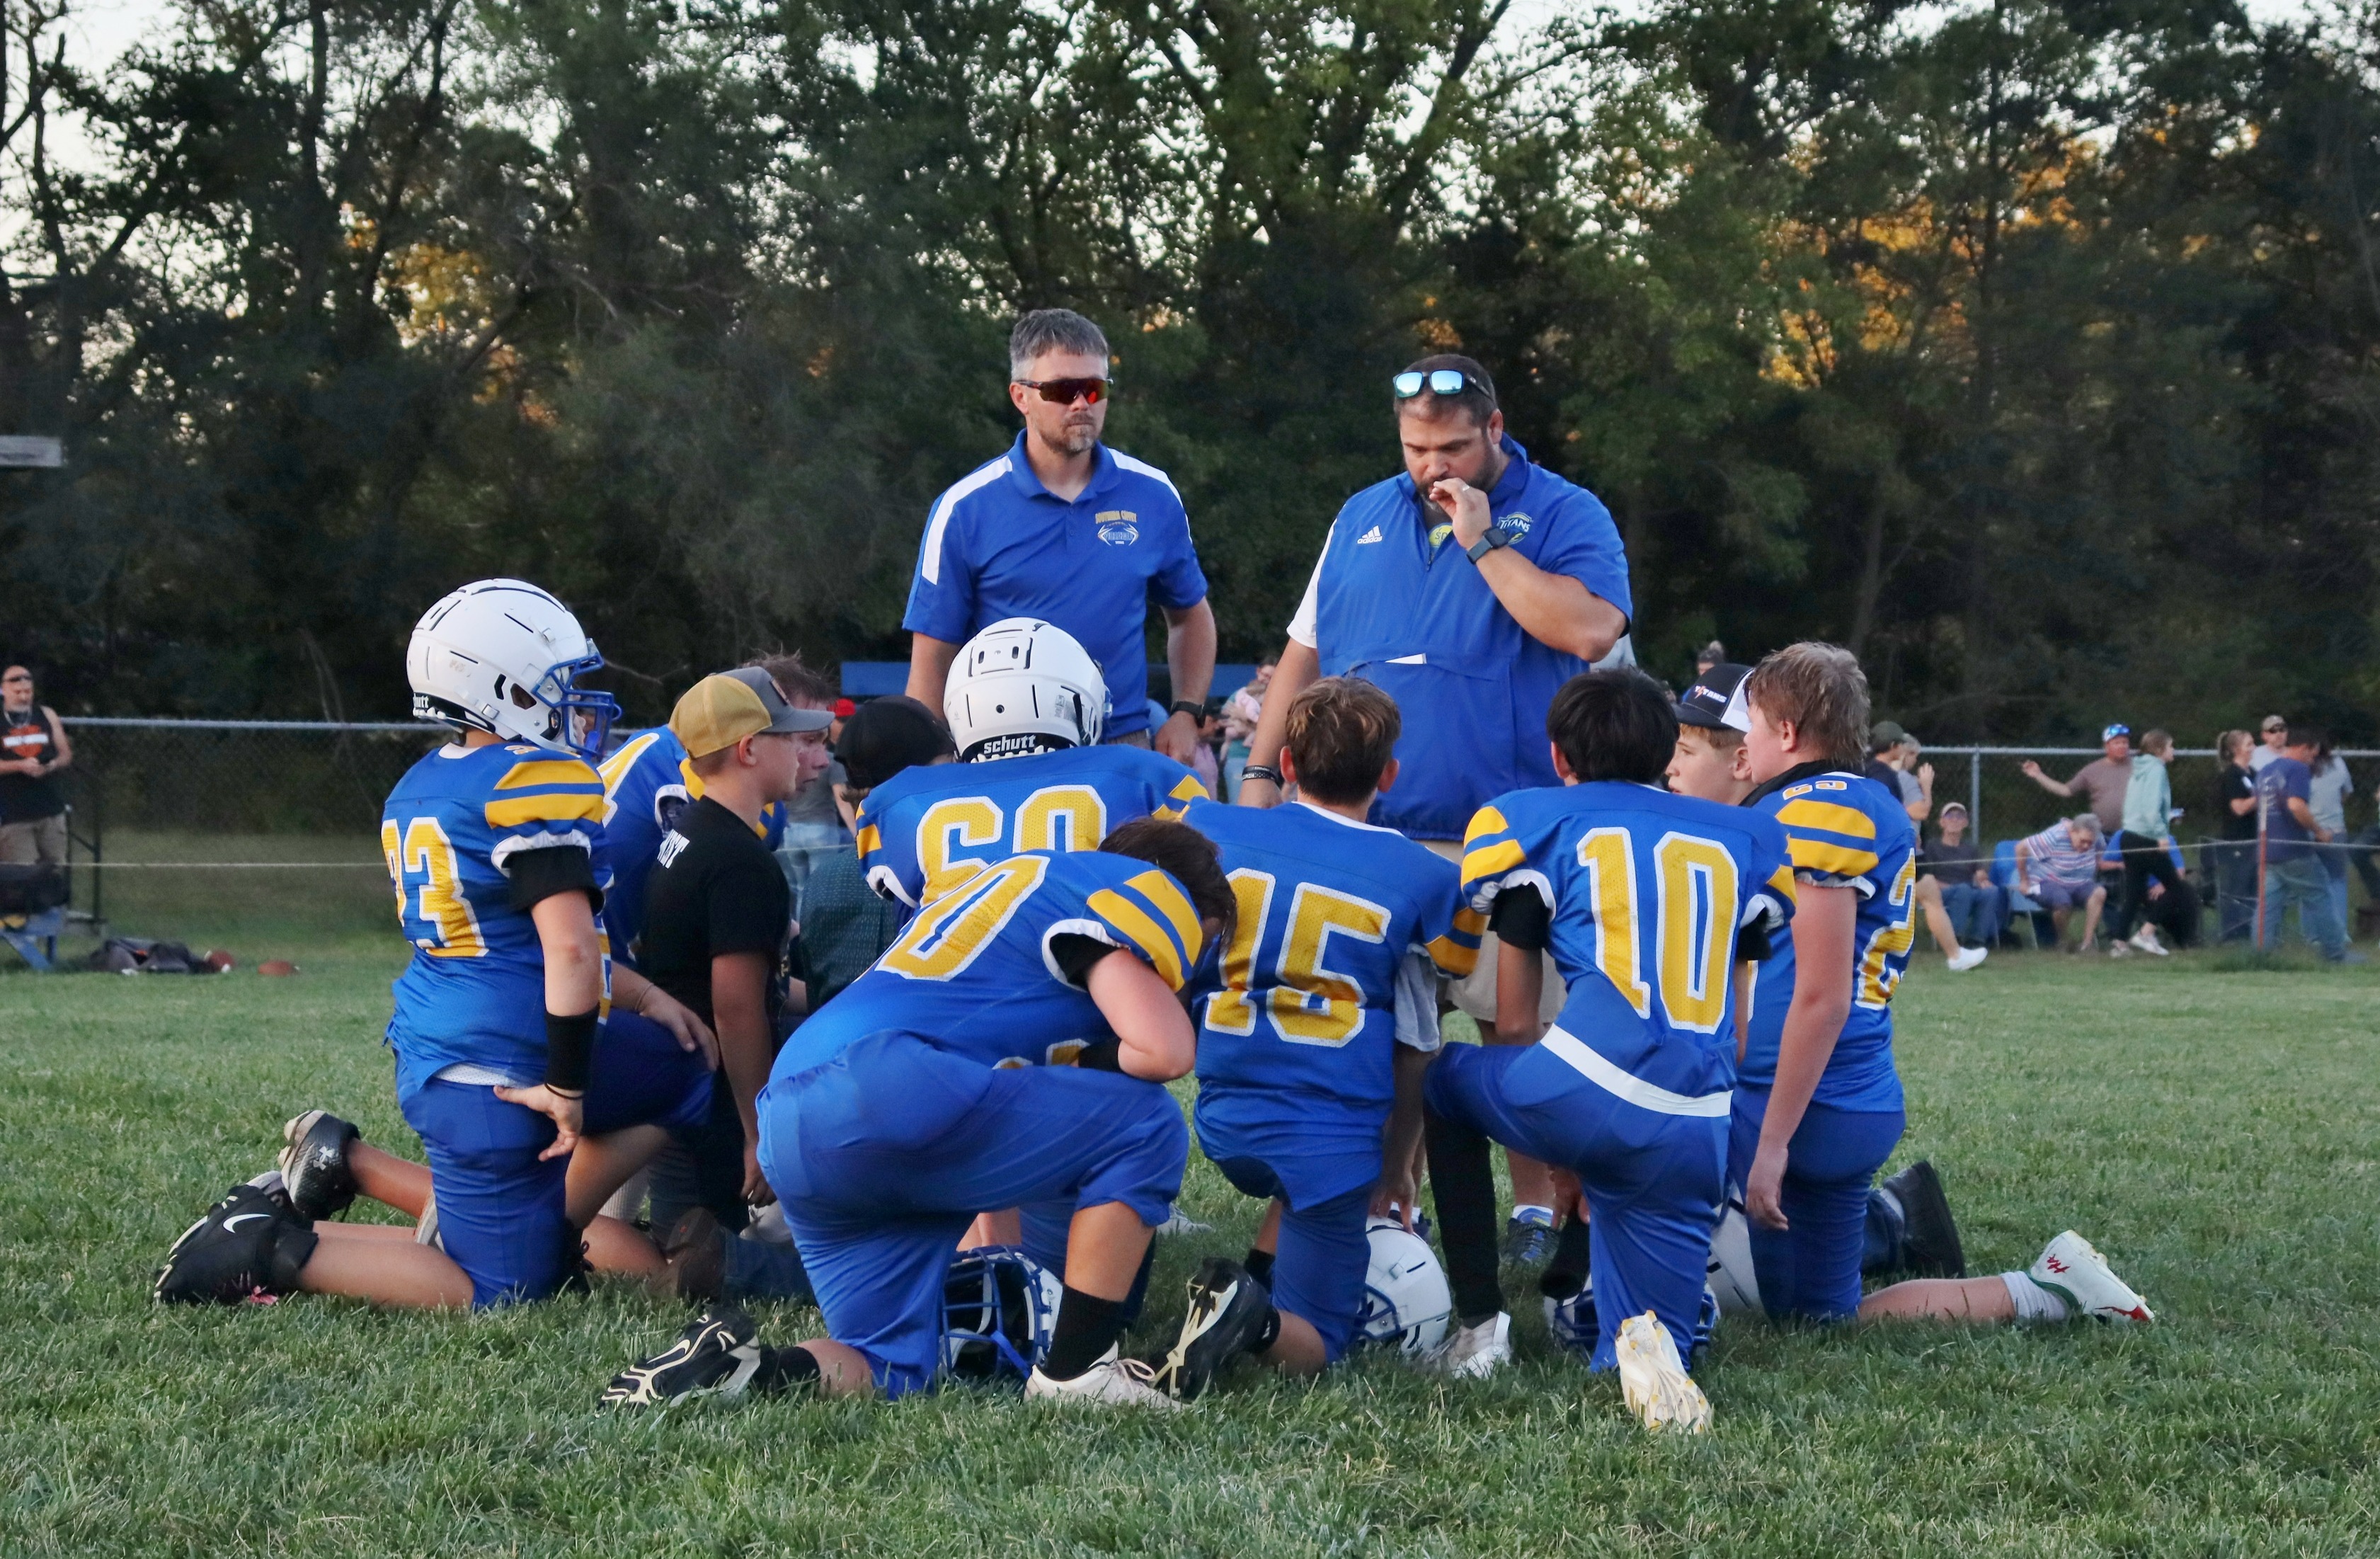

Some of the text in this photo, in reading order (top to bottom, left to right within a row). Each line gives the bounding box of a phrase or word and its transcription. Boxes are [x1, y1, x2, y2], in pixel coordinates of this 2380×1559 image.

[1357, 535, 1383, 544] adidas
[1499, 518, 1531, 532] TITANS
[983, 734, 1036, 755] schutt
[858, 855, 1051, 982] 0
[1577, 826, 1739, 1034] 10
[1205, 867, 1392, 1048] 15
